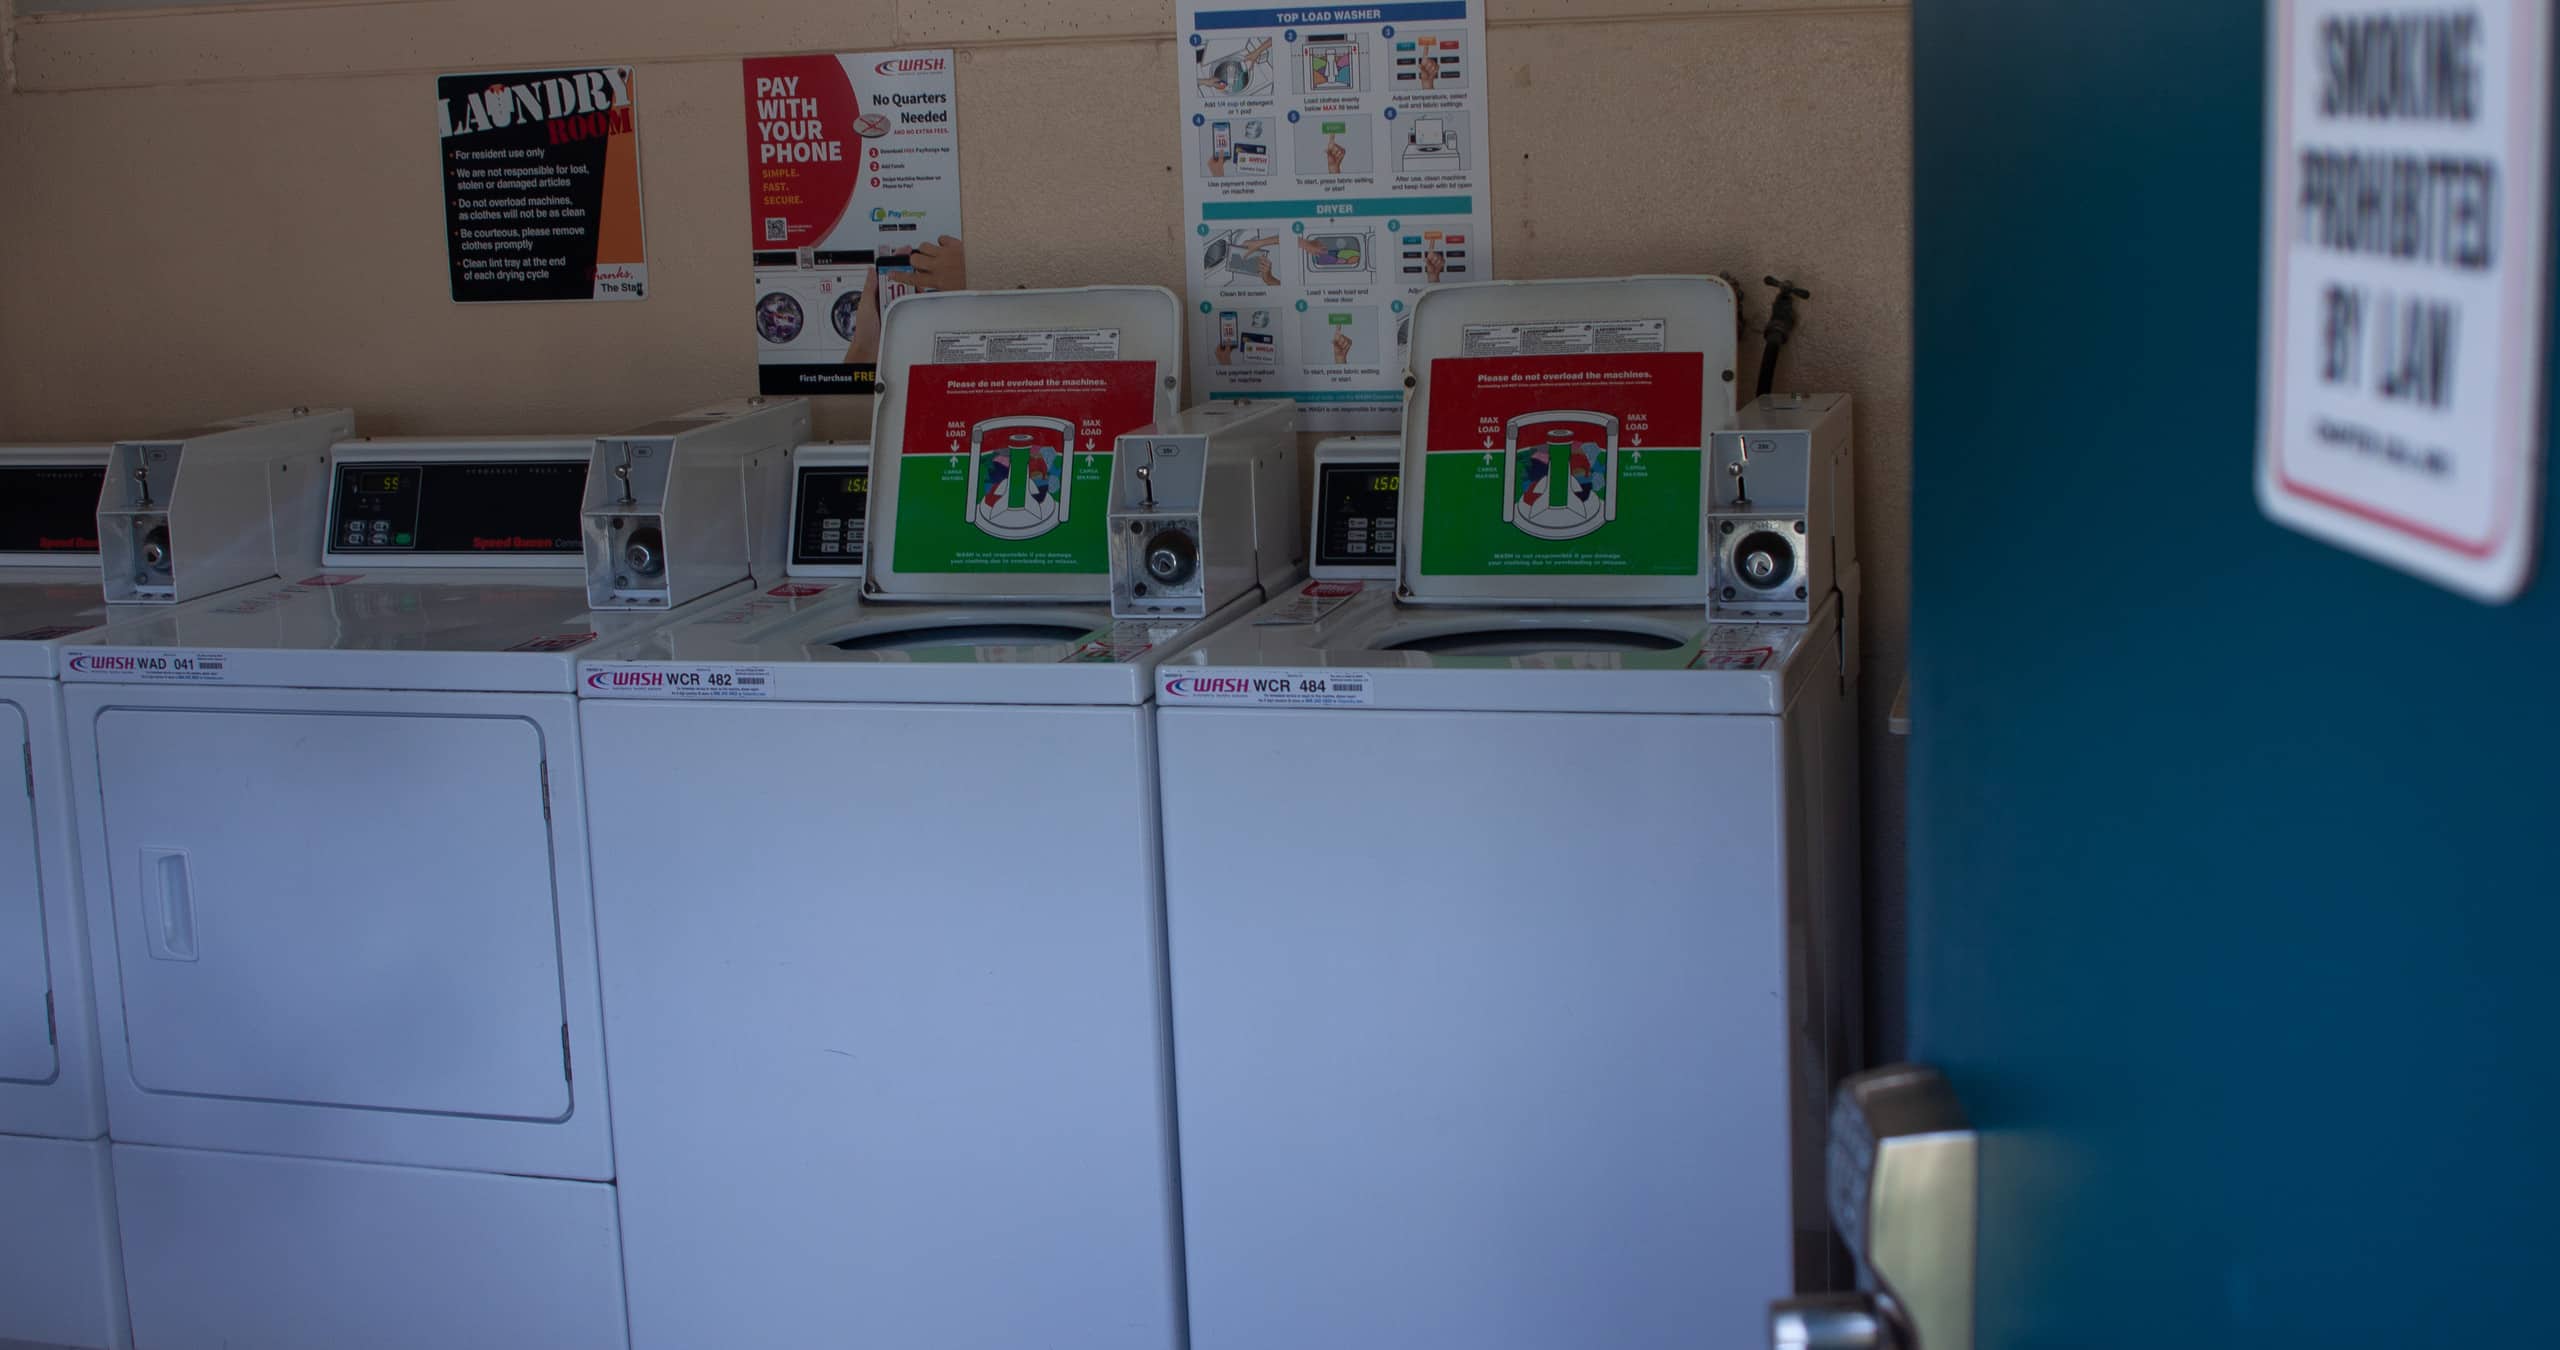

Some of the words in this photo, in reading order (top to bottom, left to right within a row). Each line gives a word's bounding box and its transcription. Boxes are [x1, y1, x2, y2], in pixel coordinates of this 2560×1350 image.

[1277, 12, 1298, 23] TOP
[1301, 11, 1331, 22] LOAD
[1334, 9, 1381, 21] WASHER
[898, 58, 945, 72] WASH
[757, 76, 800, 98] PAY
[440, 67, 632, 138] LAUNDRY
[872, 94, 890, 106] No
[892, 92, 947, 107] Quarters
[757, 98, 819, 119] WITH
[900, 110, 947, 124] Needed
[547, 109, 632, 144] ROOM
[758, 120, 824, 142] YOUR
[455, 150, 469, 160] For
[472, 149, 507, 159] resident
[508, 150, 524, 158] use
[526, 147, 545, 160] only
[761, 141, 843, 164] PHONE
[456, 168, 470, 178] We
[472, 169, 486, 178] are
[487, 168, 502, 177] not
[503, 165, 555, 178] responsible
[556, 164, 568, 175] for
[569, 163, 590, 176] lost,
[761, 168, 800, 178] SIMPLE.
[457, 180, 484, 190] stolen
[485, 181, 495, 190] or
[496, 178, 537, 191] damaged
[538, 177, 572, 188] articles
[763, 182, 789, 192] FAST.
[458, 199, 471, 208] Do
[472, 198, 487, 207] not
[488, 196, 527, 207] overload
[527, 195, 573, 207] machines,
[763, 195, 804, 205] SECURE.
[458, 212, 469, 220] as
[470, 210, 502, 220] clothes
[503, 209, 518, 219] will
[519, 208, 535, 218] not
[536, 208, 547, 218] be
[549, 209, 560, 218] as
[561, 207, 586, 217] clean
[1316, 204, 1353, 214] DRYER
[460, 228, 472, 238] Be
[474, 227, 521, 239] courteous,
[522, 226, 550, 239] please
[552, 226, 585, 235] remove
[461, 240, 493, 250] clothes
[494, 239, 533, 251] promptly
[462, 258, 488, 268] Clean
[488, 257, 503, 267] lint
[504, 257, 521, 269] tray
[522, 257, 532, 267] at
[533, 256, 548, 266] the
[549, 255, 566, 265] end
[464, 270, 473, 280] of
[474, 269, 495, 279] each
[496, 269, 525, 282] drying
[526, 268, 549, 281] cycle
[601, 283, 619, 293] The
[888, 284, 906, 300] 10
[800, 374, 817, 382] First
[817, 373, 852, 382] Purchase
[853, 371, 876, 382] FRE
[947, 380, 976, 389] Please
[978, 380, 989, 388] do
[991, 380, 1004, 388] not
[1006, 378, 1044, 387] overload
[1046, 377, 1060, 386] the
[1062, 376, 1107, 386] machines.
[1478, 373, 1509, 382] Please
[1511, 373, 1523, 381] do
[1525, 373, 1540, 381] not
[1543, 371, 1584, 380] overload
[1586, 370, 1600, 379] the
[1603, 370, 1652, 380] machines.
[1082, 419, 1101, 427] MAX
[1479, 416, 1499, 424] MAX
[1626, 413, 1647, 421] MAX
[947, 421, 966, 429] MAX
[1477, 425, 1500, 433] LOAD
[1625, 423, 1648, 431] LOAD
[946, 430, 967, 438] LOAD
[1080, 428, 1102, 436] LOAD
[473, 536, 512, 550] Speed
[513, 536, 553, 548] Queen
[91, 655, 134, 670] WASH
[137, 658, 167, 670] WAD
[174, 658, 194, 670] 041
[612, 672, 663, 686] WASH
[666, 673, 700, 686] WCR
[707, 673, 732, 686] 482
[1193, 678, 1249, 693] WASH
[1253, 679, 1290, 693] WCR
[1299, 679, 1326, 693] 484
